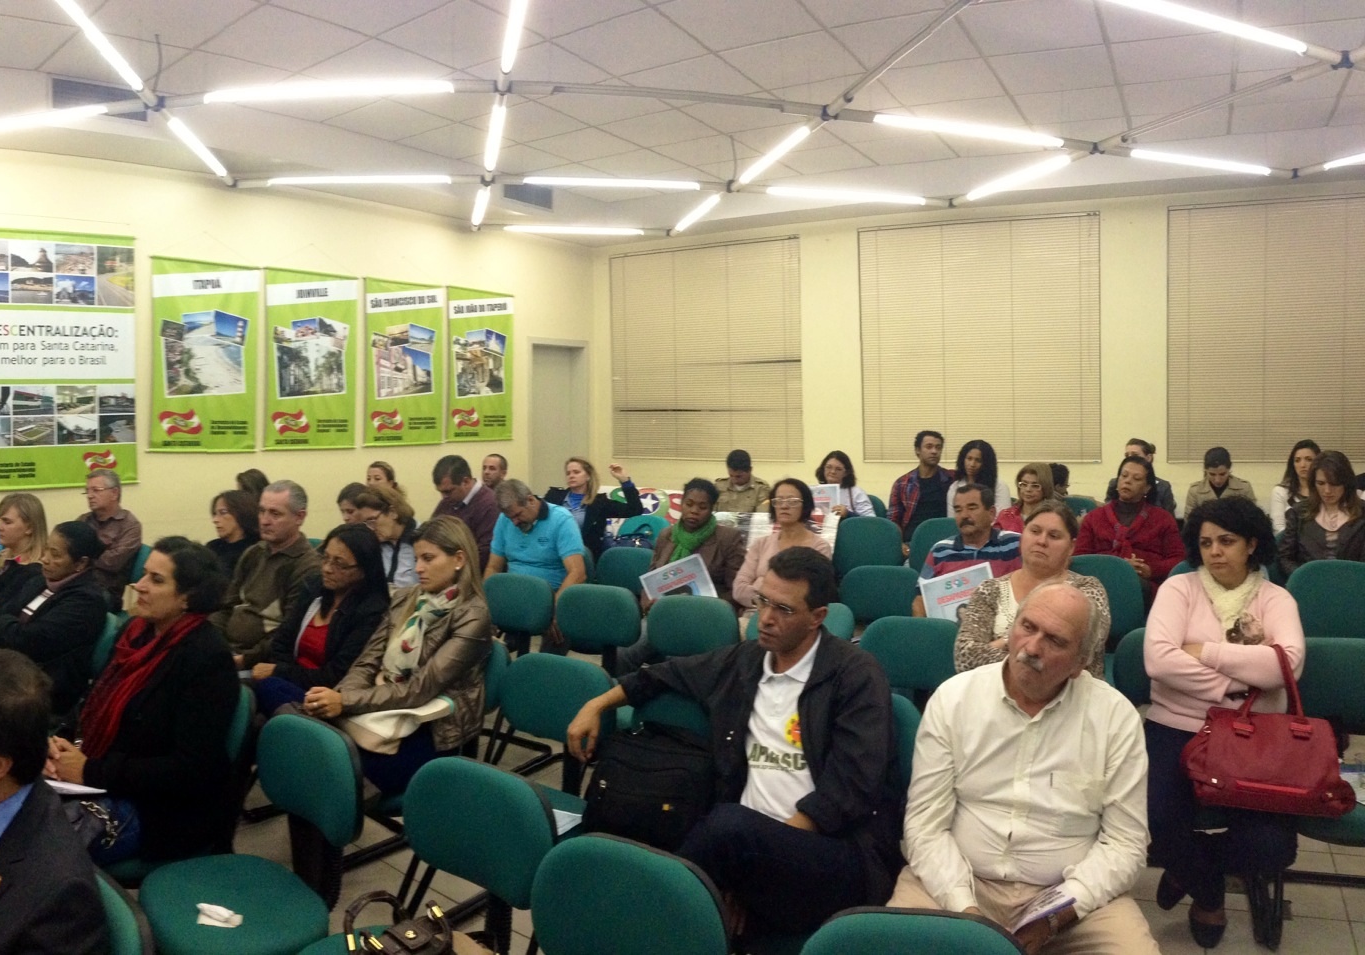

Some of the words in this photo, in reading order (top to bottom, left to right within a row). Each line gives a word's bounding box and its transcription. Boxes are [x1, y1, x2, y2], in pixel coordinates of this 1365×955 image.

[13, 342, 35, 352] para
[41, 340, 69, 351] Santa
[1, 355, 37, 365] melhor
[42, 356, 65, 367] para
[69, 357, 76, 365] o
[78, 355, 107, 365] Brasil
